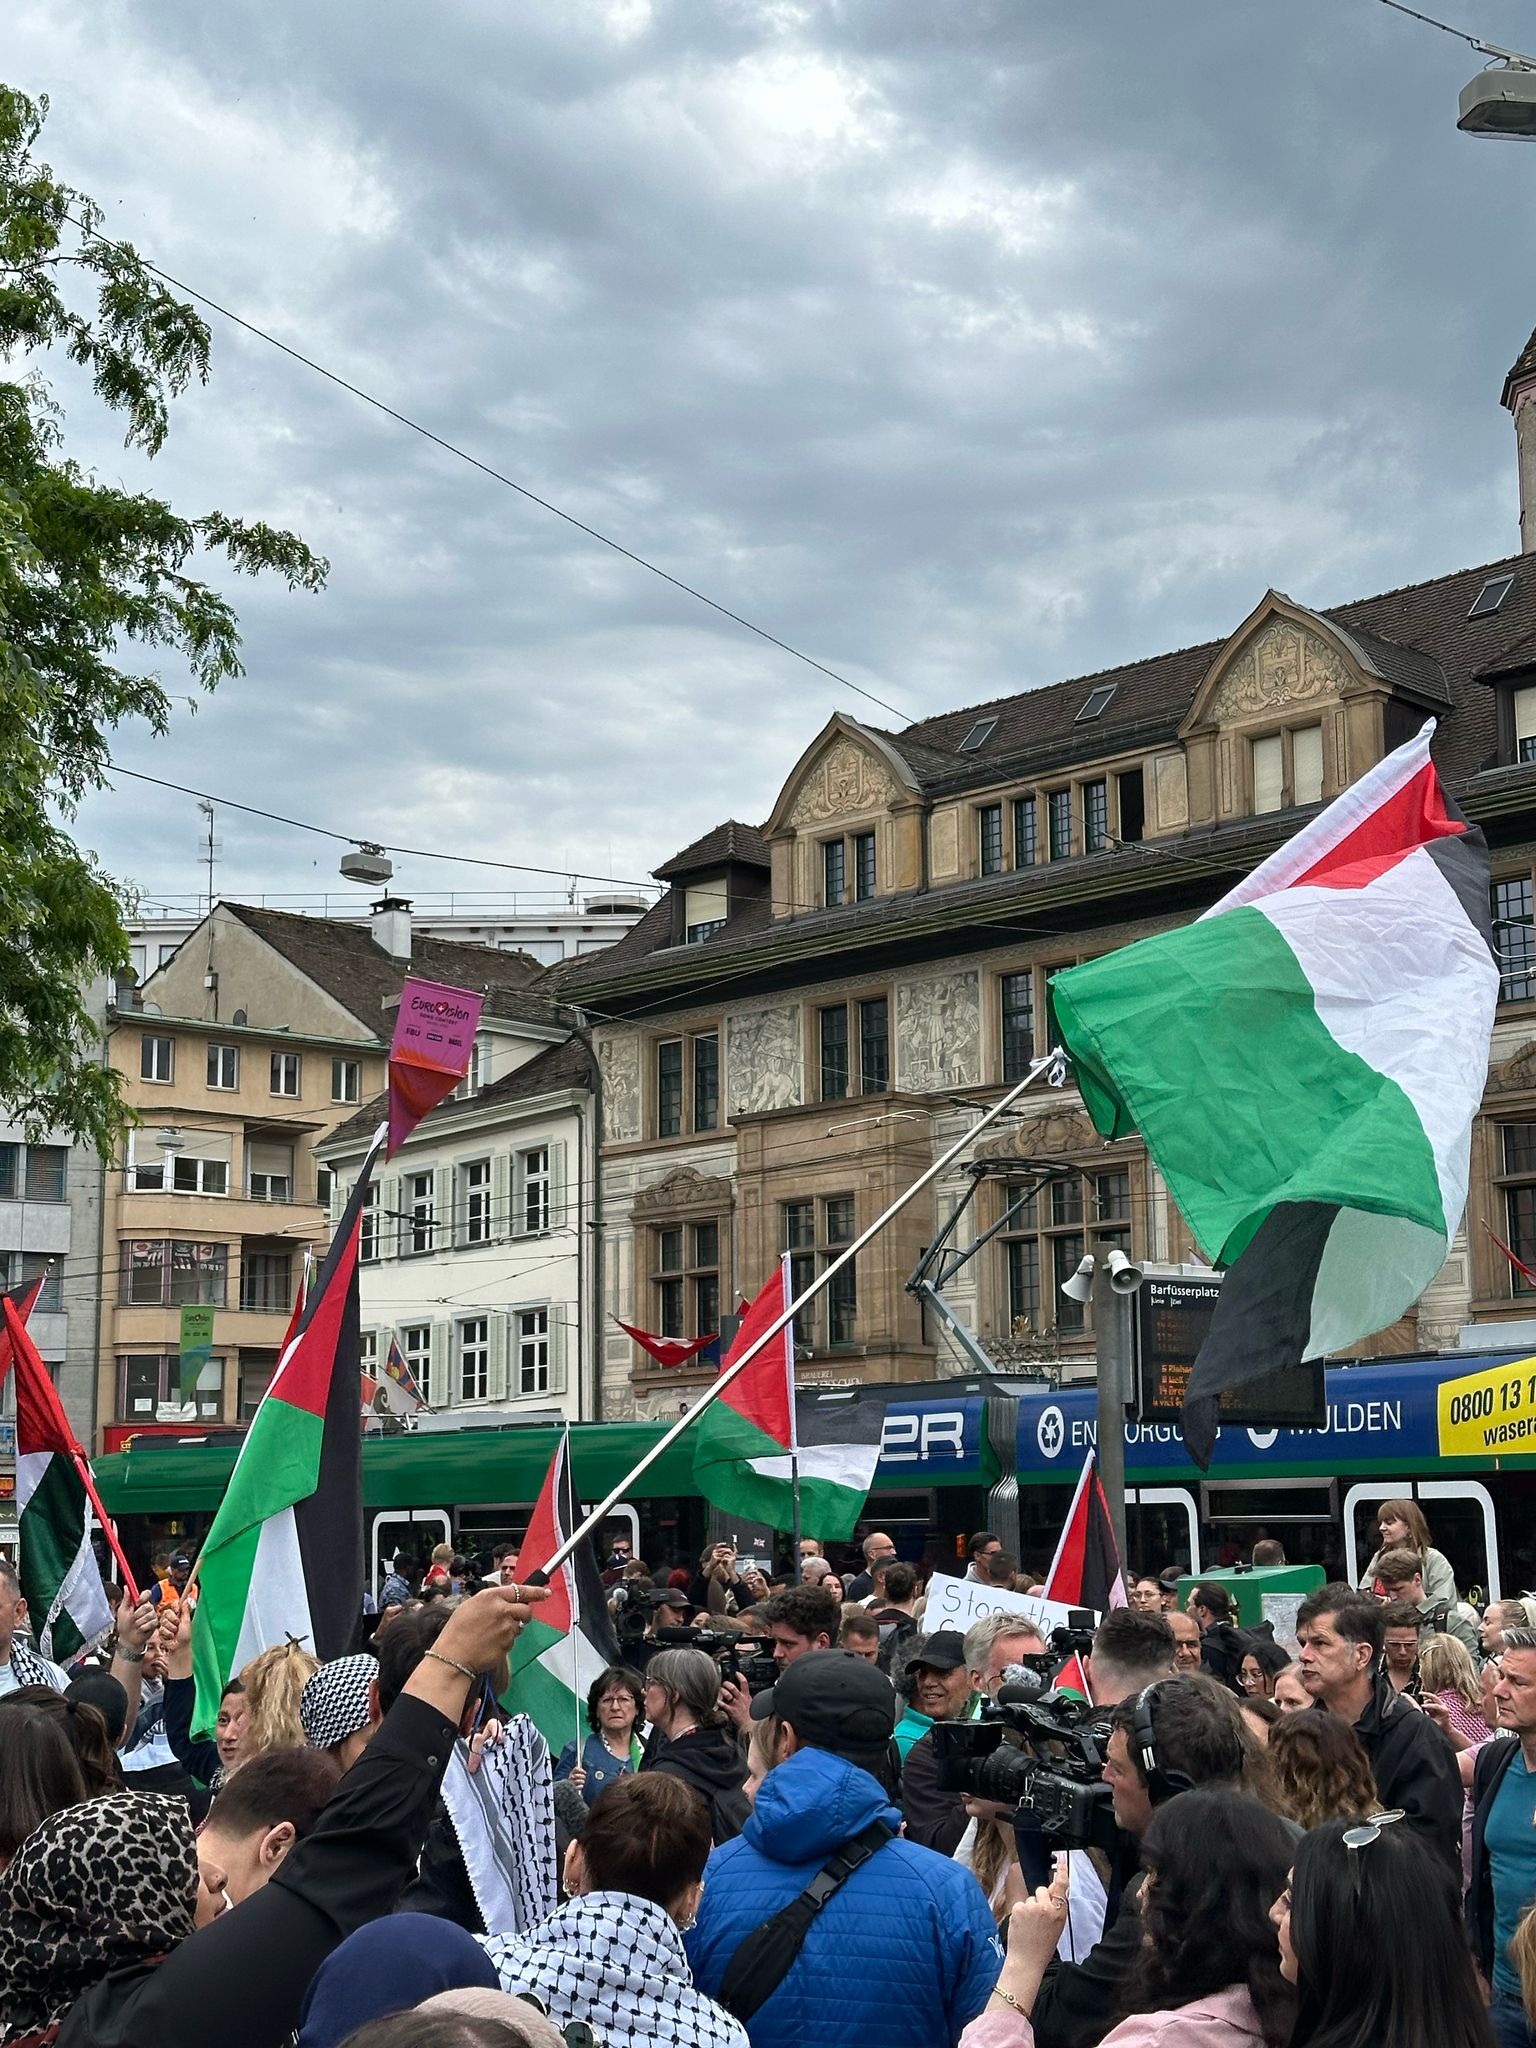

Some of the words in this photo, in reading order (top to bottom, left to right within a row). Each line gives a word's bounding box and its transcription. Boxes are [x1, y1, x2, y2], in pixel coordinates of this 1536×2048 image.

[1150, 1284, 1220, 1299] Barfüsserplatz
[1290, 1401, 1401, 1434] ULDEN
[1451, 1387, 1494, 1425] 0800
[1500, 1379, 1522, 1412] 13
